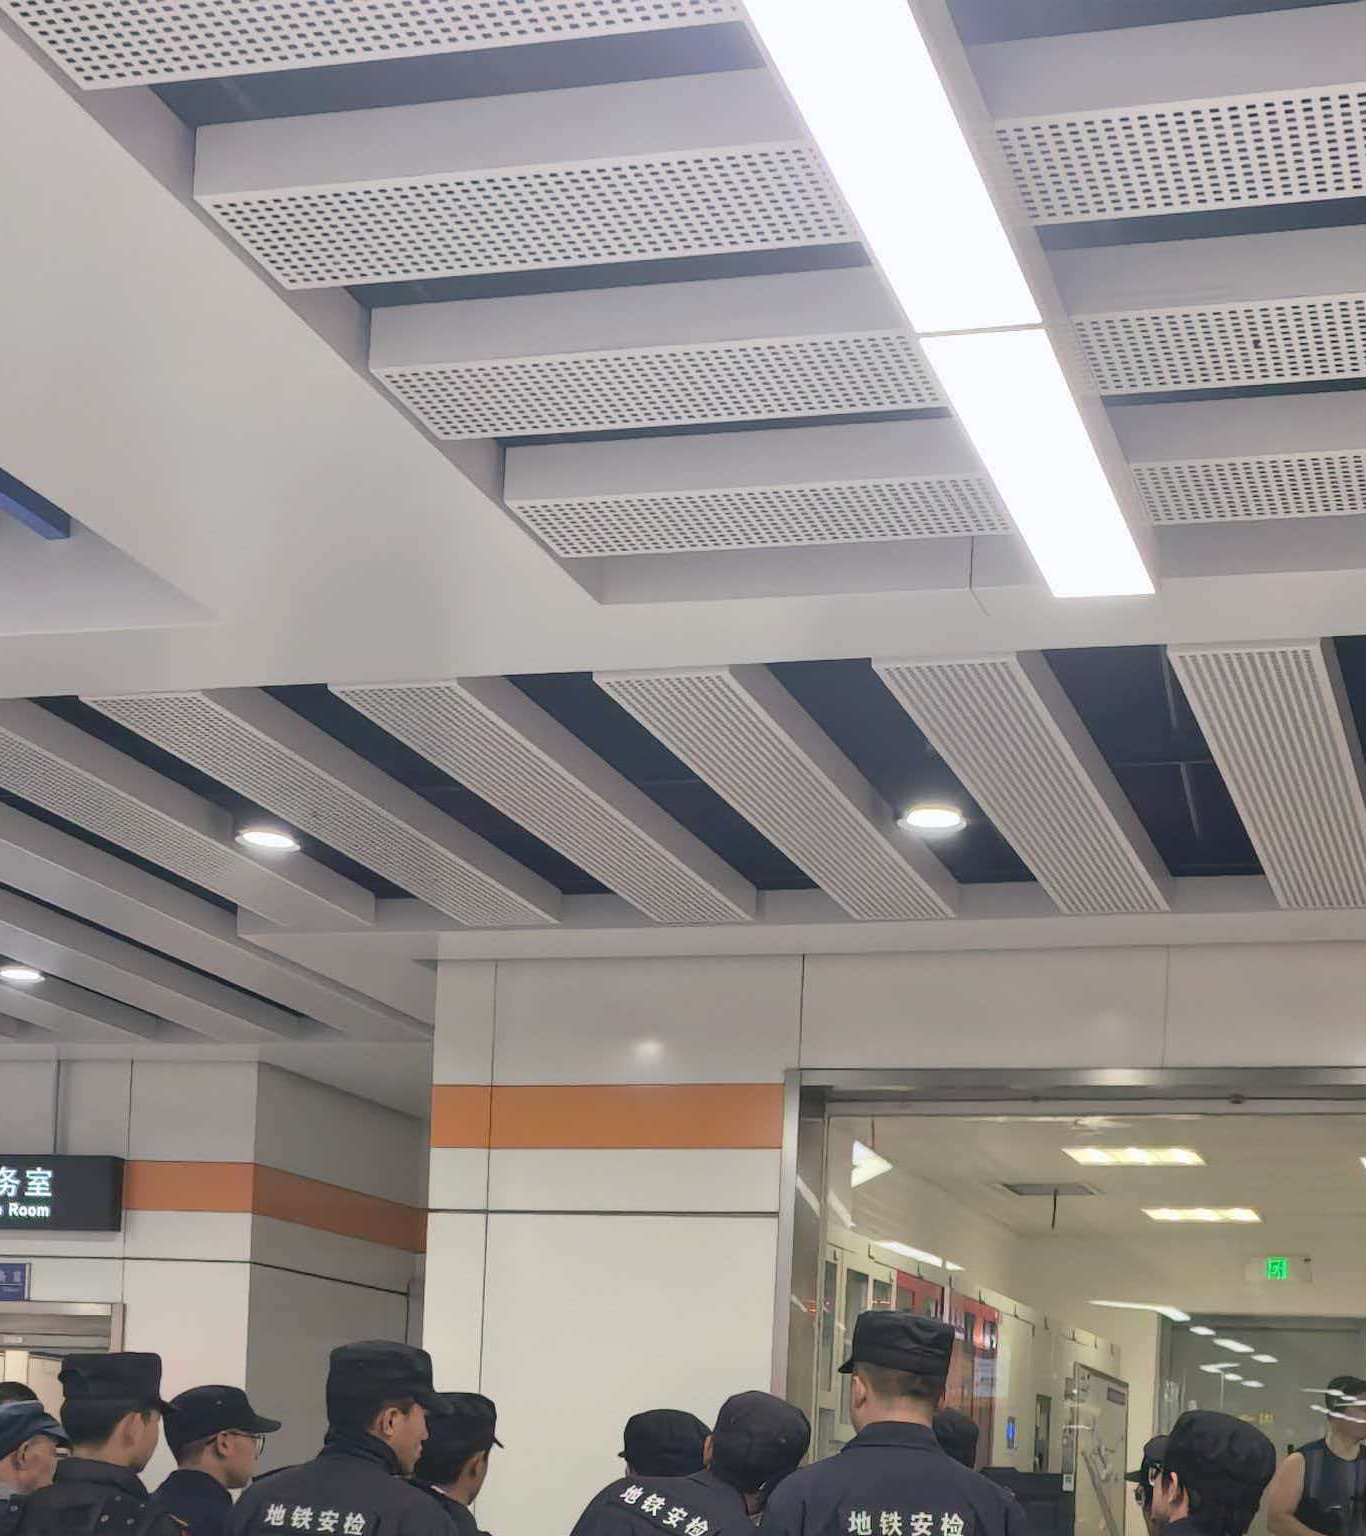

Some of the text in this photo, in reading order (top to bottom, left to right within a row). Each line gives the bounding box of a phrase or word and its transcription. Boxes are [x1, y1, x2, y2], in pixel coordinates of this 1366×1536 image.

[9, 1203, 50, 1218] Room
[263, 1502, 367, 1536] 地铁安检
